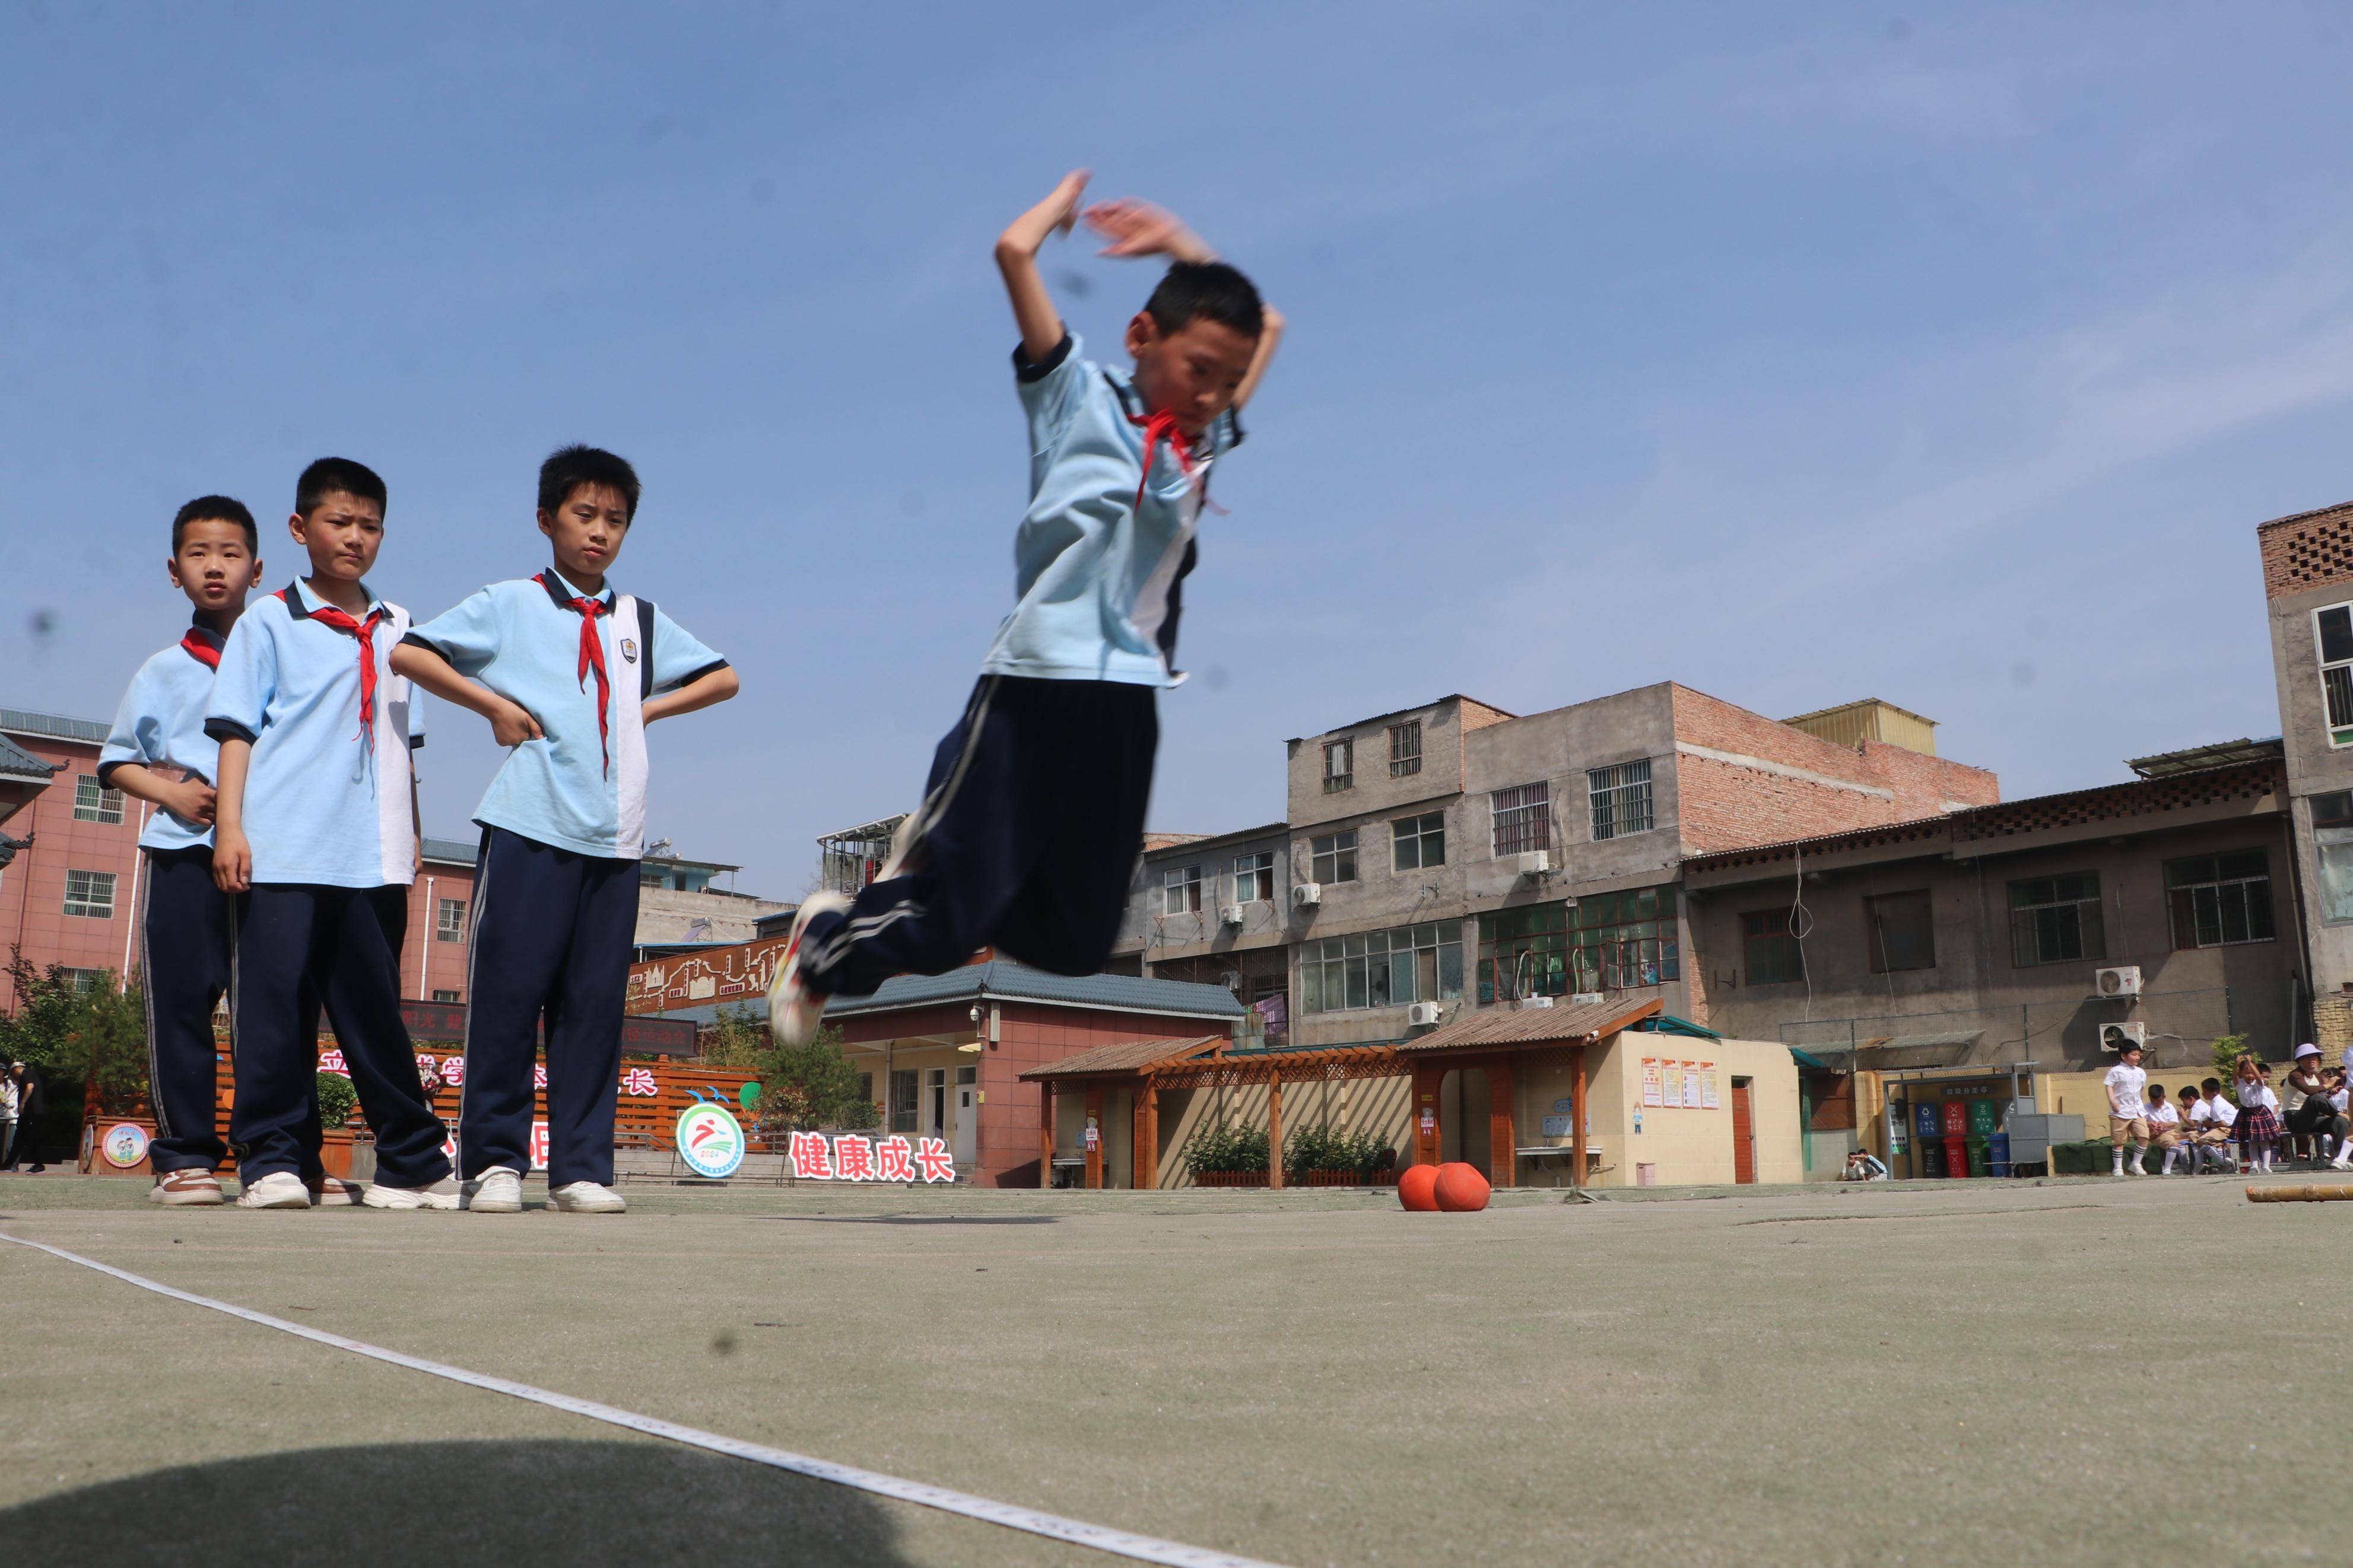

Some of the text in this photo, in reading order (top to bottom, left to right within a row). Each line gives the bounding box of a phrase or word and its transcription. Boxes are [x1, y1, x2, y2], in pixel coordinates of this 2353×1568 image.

[401, 1010, 437, 1029] 阳光
[622, 1026, 686, 1045] 径运动会
[624, 1069, 657, 1095] 长
[1946, 1086, 1988, 1095] 垃圾分类亭
[700, 1150, 719, 1158] 2024
[790, 1134, 954, 1181] 健康成长
